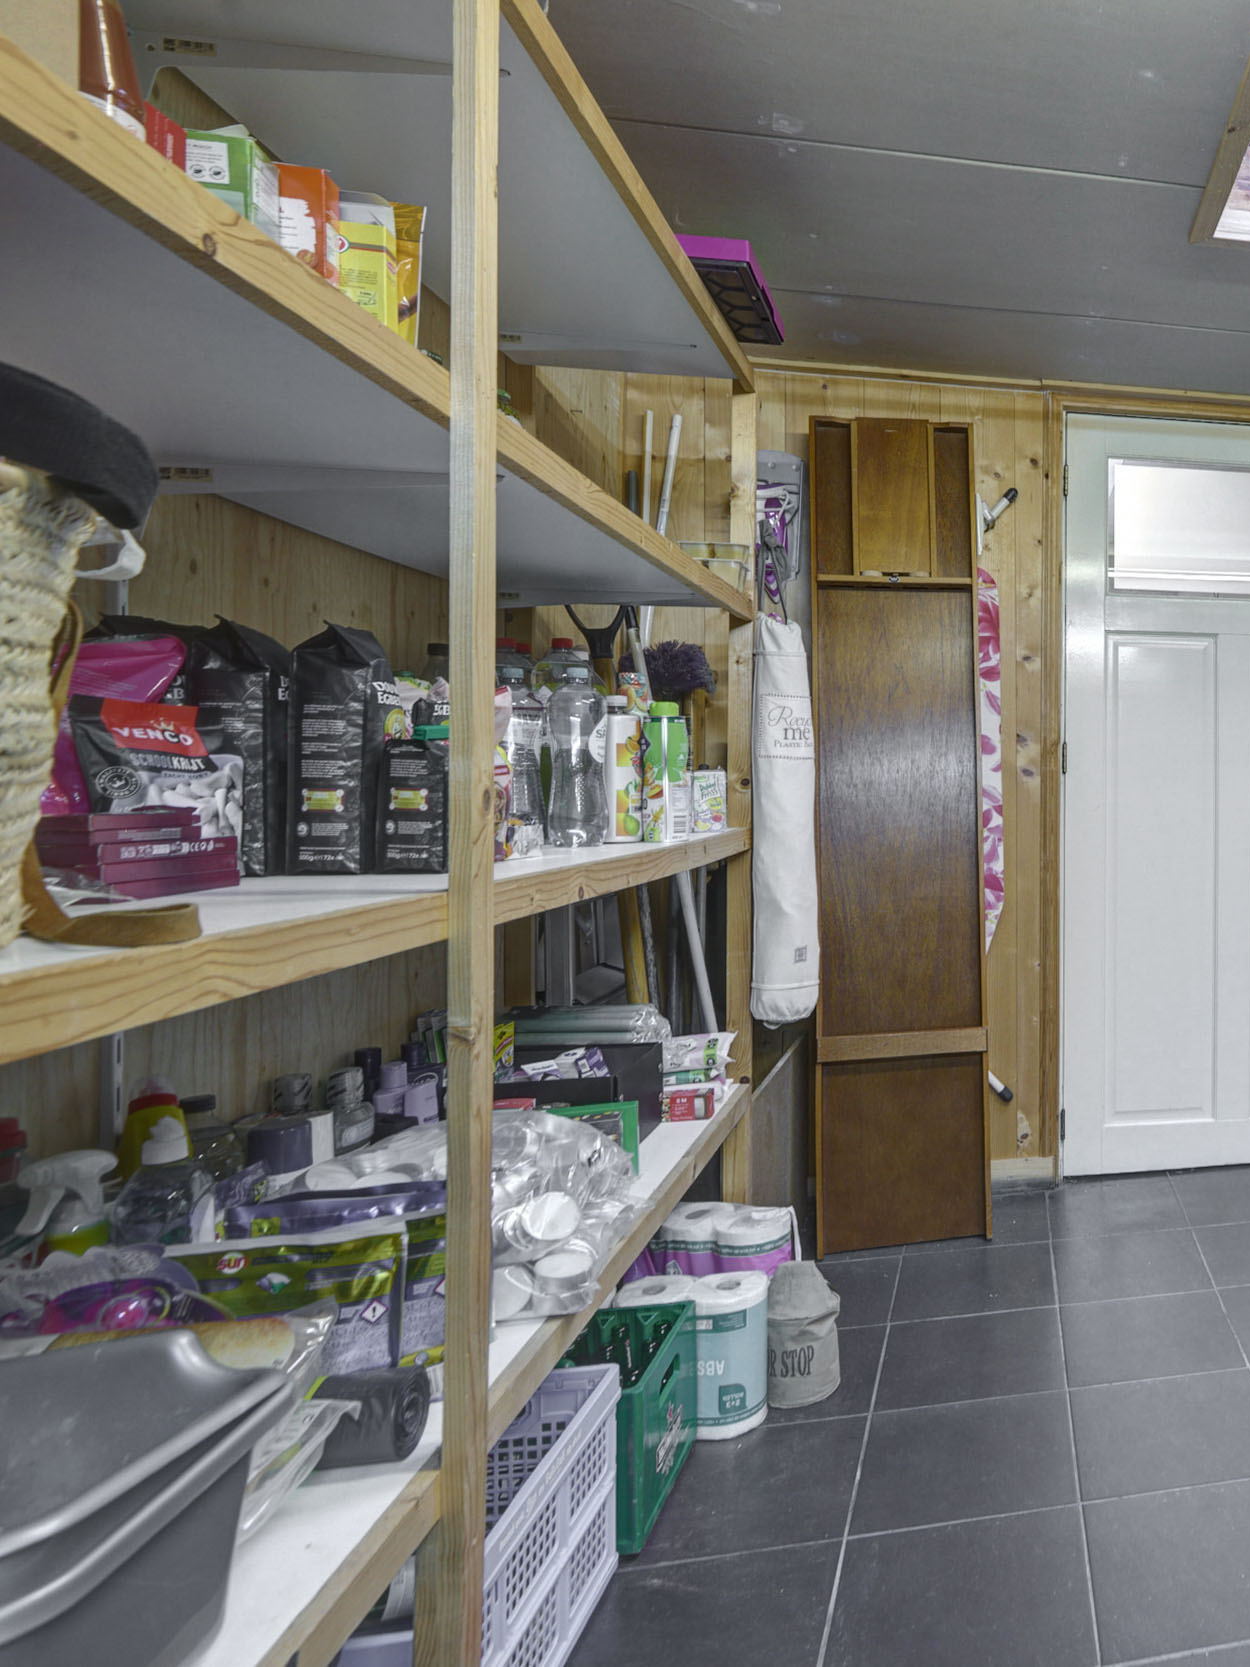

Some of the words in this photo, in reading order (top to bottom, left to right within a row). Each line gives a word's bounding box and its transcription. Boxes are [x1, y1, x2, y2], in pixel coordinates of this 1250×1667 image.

[111, 726, 195, 747] VENCO
[783, 727, 811, 740] me
[780, 1344, 815, 1378] STOP
